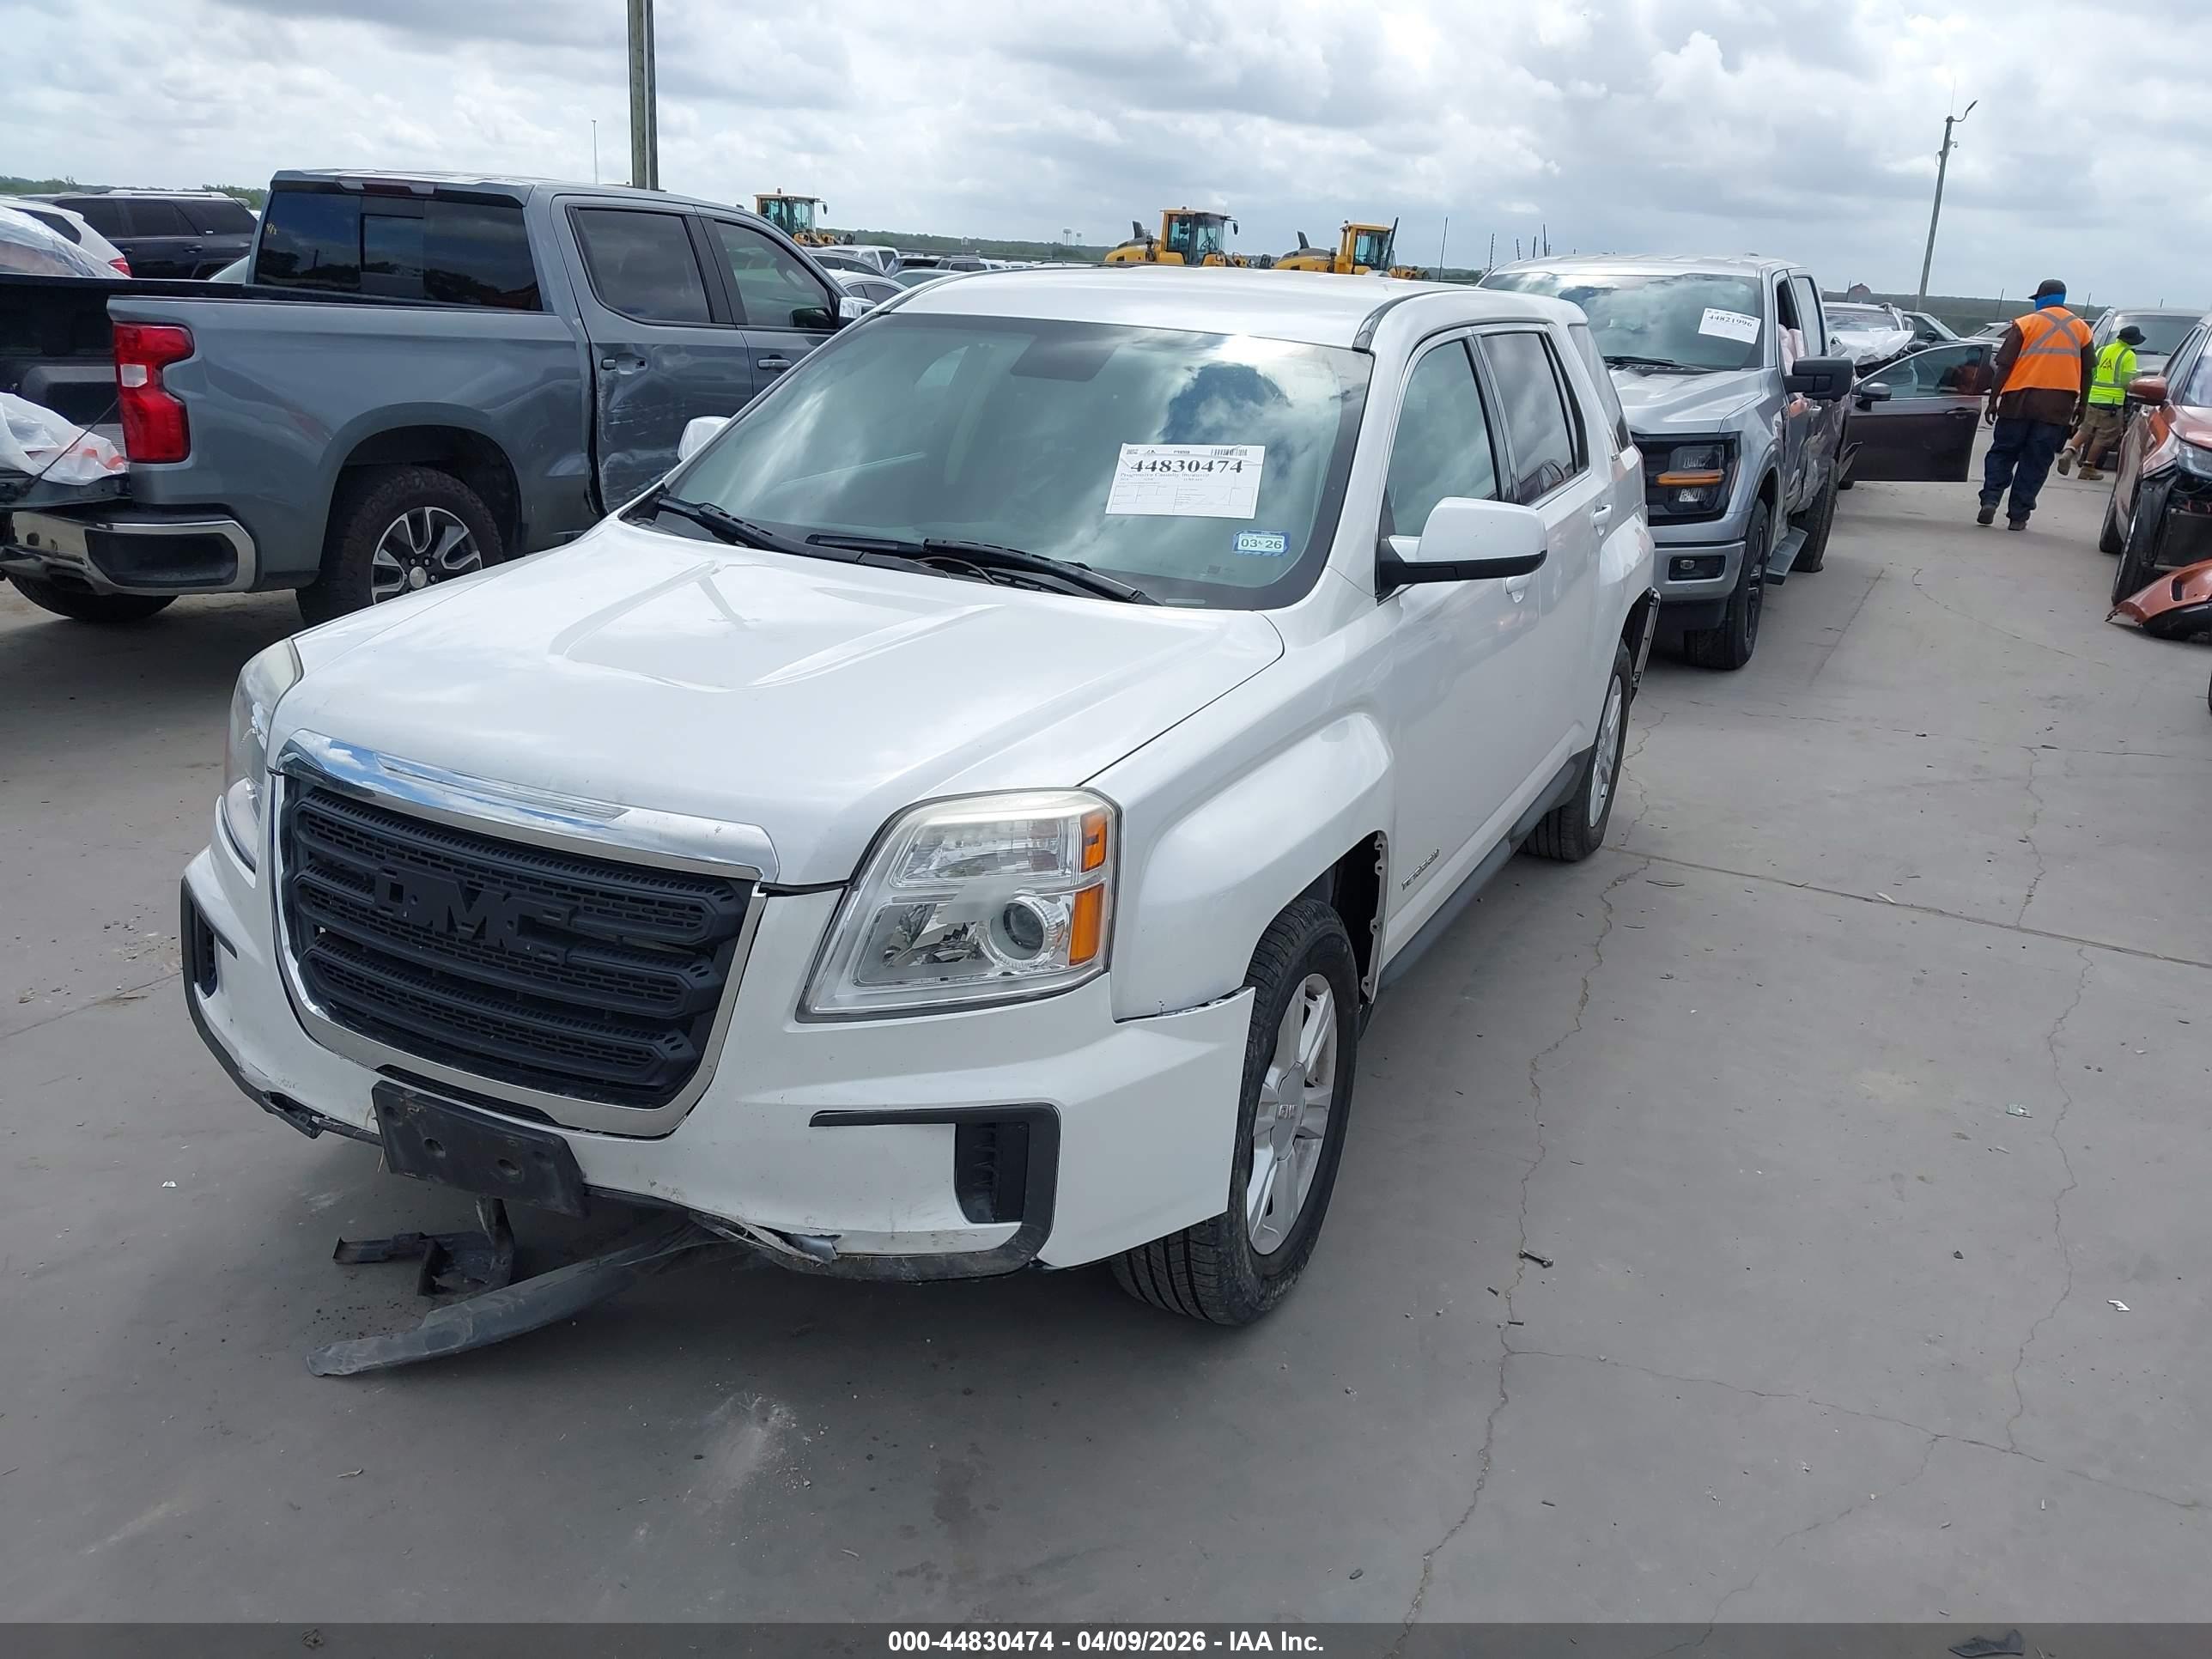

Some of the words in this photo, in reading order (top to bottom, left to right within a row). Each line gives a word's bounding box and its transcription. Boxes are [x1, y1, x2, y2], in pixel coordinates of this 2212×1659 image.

[1131, 459, 1243, 473] 44830474
[1241, 538, 1258, 548] 03
[1265, 539, 1282, 550] 26
